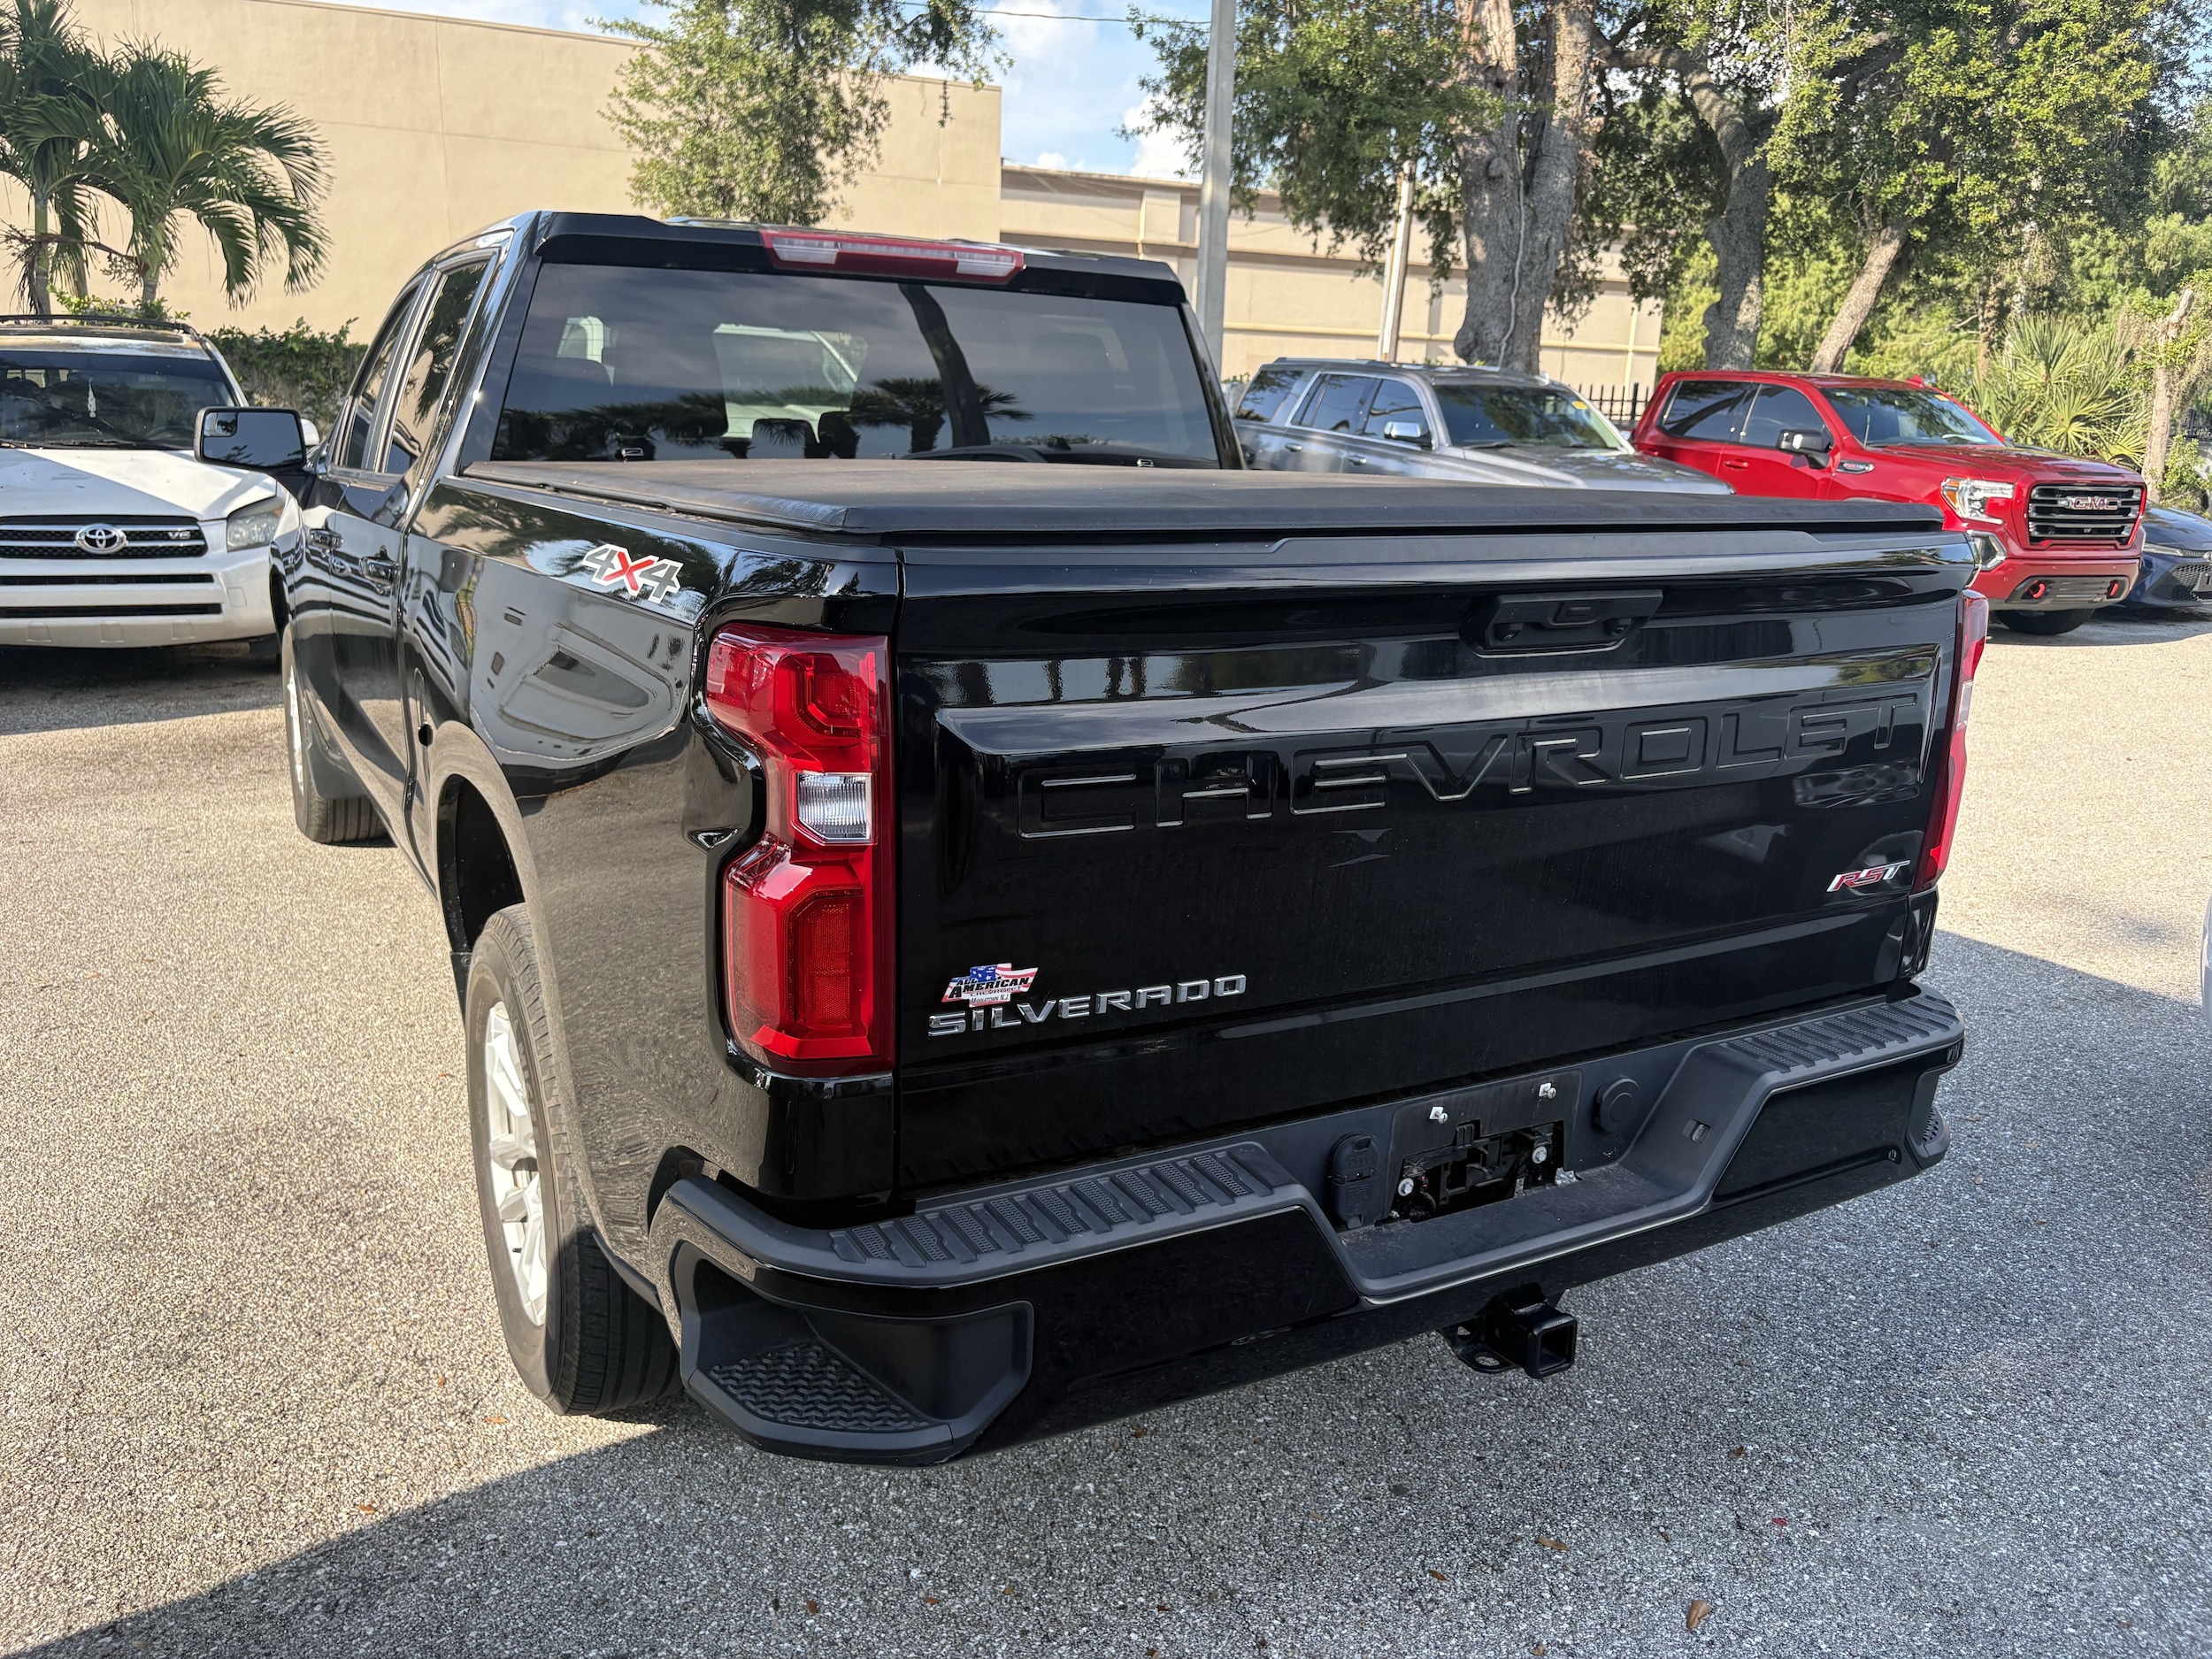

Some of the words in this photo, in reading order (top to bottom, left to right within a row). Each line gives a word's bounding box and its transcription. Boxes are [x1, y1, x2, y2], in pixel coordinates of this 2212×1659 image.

[2071, 496, 2118, 511] GMC
[168, 531, 191, 540] V6
[1017, 693, 1918, 839] CHEVROLET
[1826, 859, 1911, 892] RST
[949, 976, 1030, 998] AMERICAN
[971, 987, 1021, 996] CHEVROLET
[927, 973, 1247, 1037] SILVERADO
